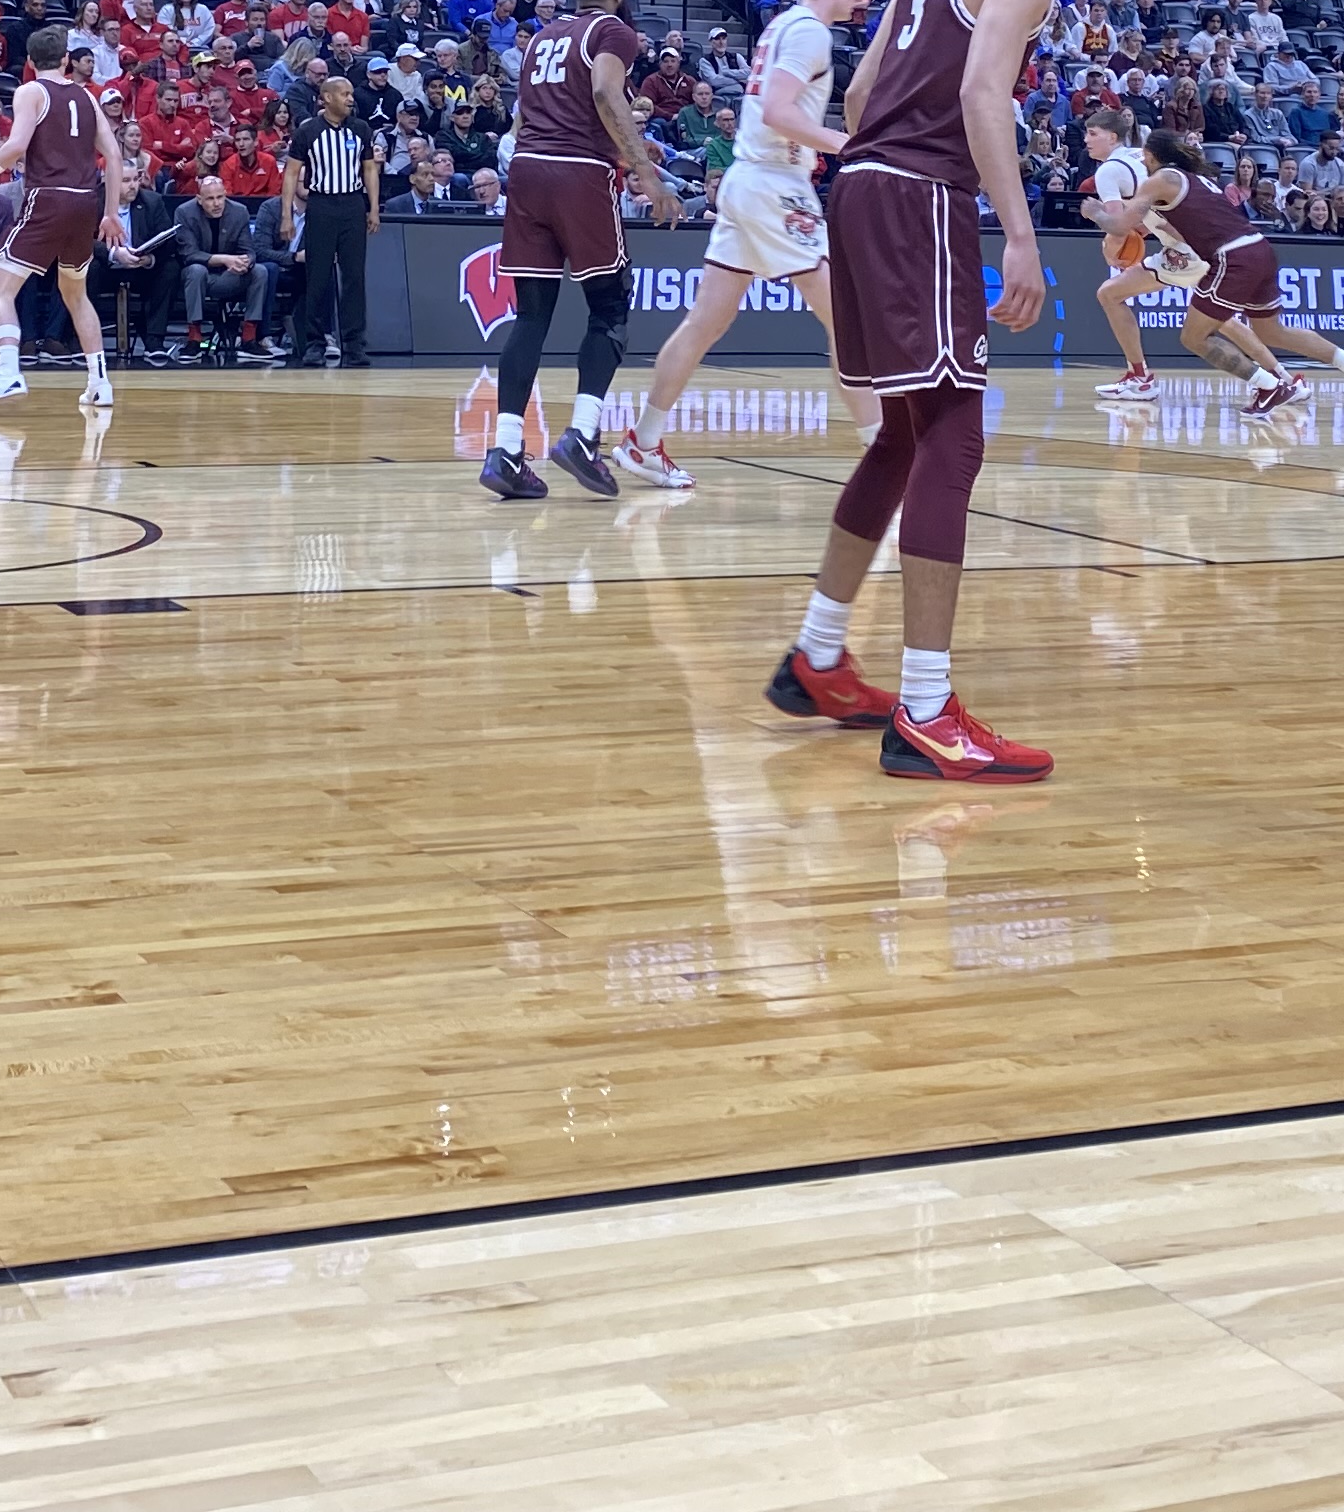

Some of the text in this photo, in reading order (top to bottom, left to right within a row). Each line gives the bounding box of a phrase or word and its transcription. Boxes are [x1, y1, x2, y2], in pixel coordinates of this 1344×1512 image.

[529, 36, 573, 86] 32
[67, 99, 80, 138] 1
[1138, 311, 1188, 329] HOSTE
